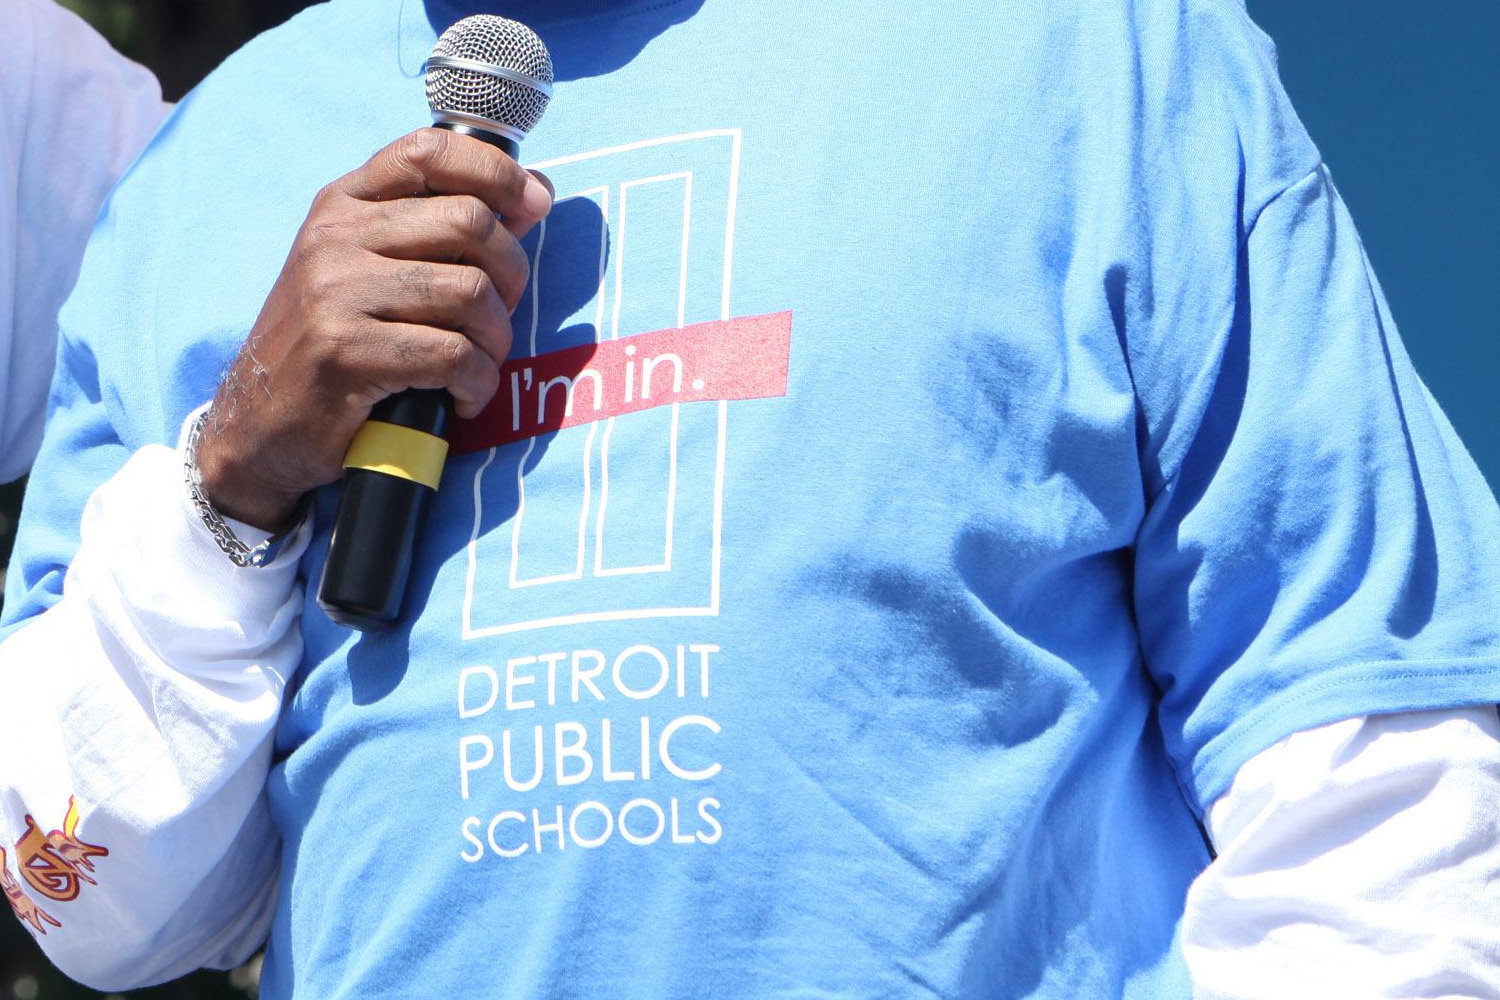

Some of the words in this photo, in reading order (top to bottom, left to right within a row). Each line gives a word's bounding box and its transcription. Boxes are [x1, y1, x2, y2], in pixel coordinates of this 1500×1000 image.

[508, 360, 604, 433] I'm
[622, 343, 708, 404] in.
[457, 643, 721, 719] DETROIT
[458, 714, 723, 800] PUBLIC
[459, 797, 723, 864] SCHOOLS
